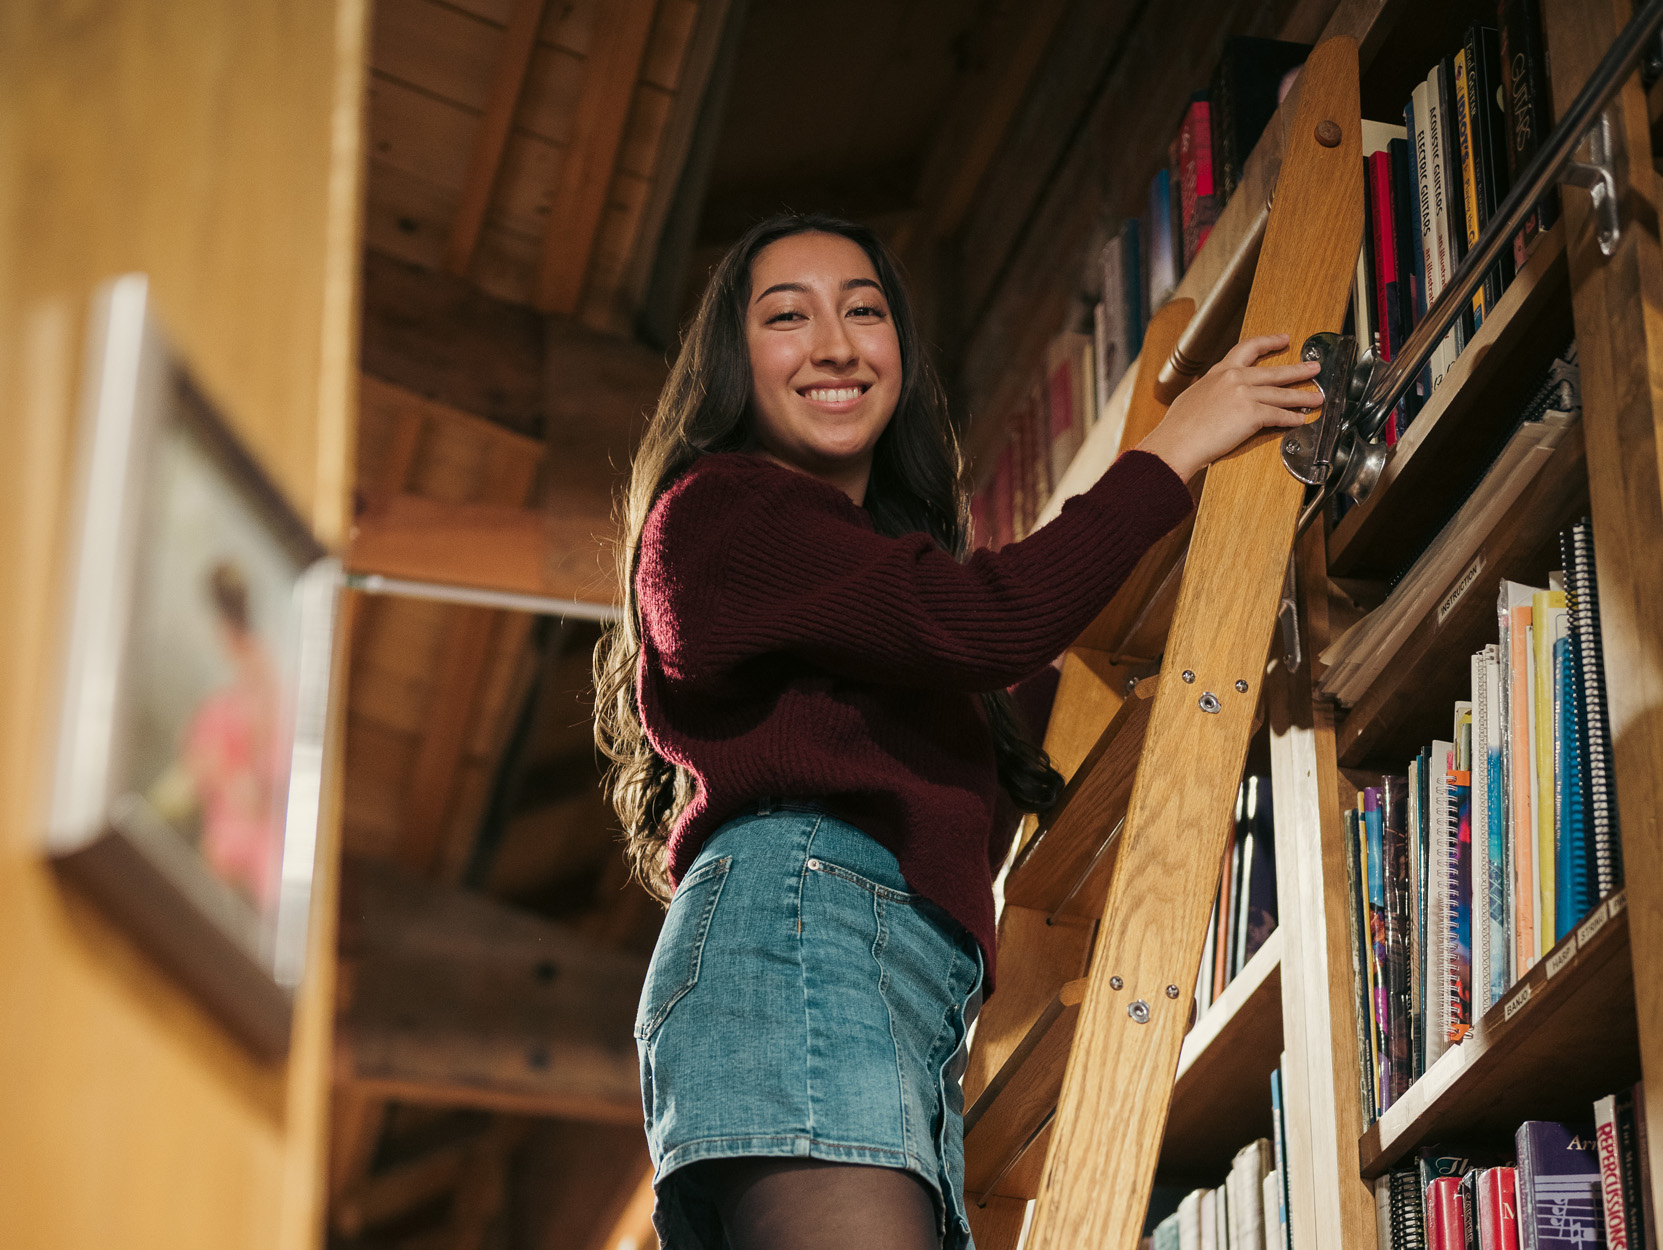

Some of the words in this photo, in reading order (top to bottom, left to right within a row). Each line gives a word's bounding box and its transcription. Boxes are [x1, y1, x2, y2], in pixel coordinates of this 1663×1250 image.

[1417, 130, 1428, 183] ELECTRIC
[1429, 107, 1440, 164] ACOUSTIC
[1420, 184, 1432, 237] GUITARS
[1432, 164, 1443, 216] GUITARS
[1440, 565, 1478, 616] INSTRUCTION
[1552, 946, 1572, 971] HARP
[1506, 989, 1529, 1016] BANJO
